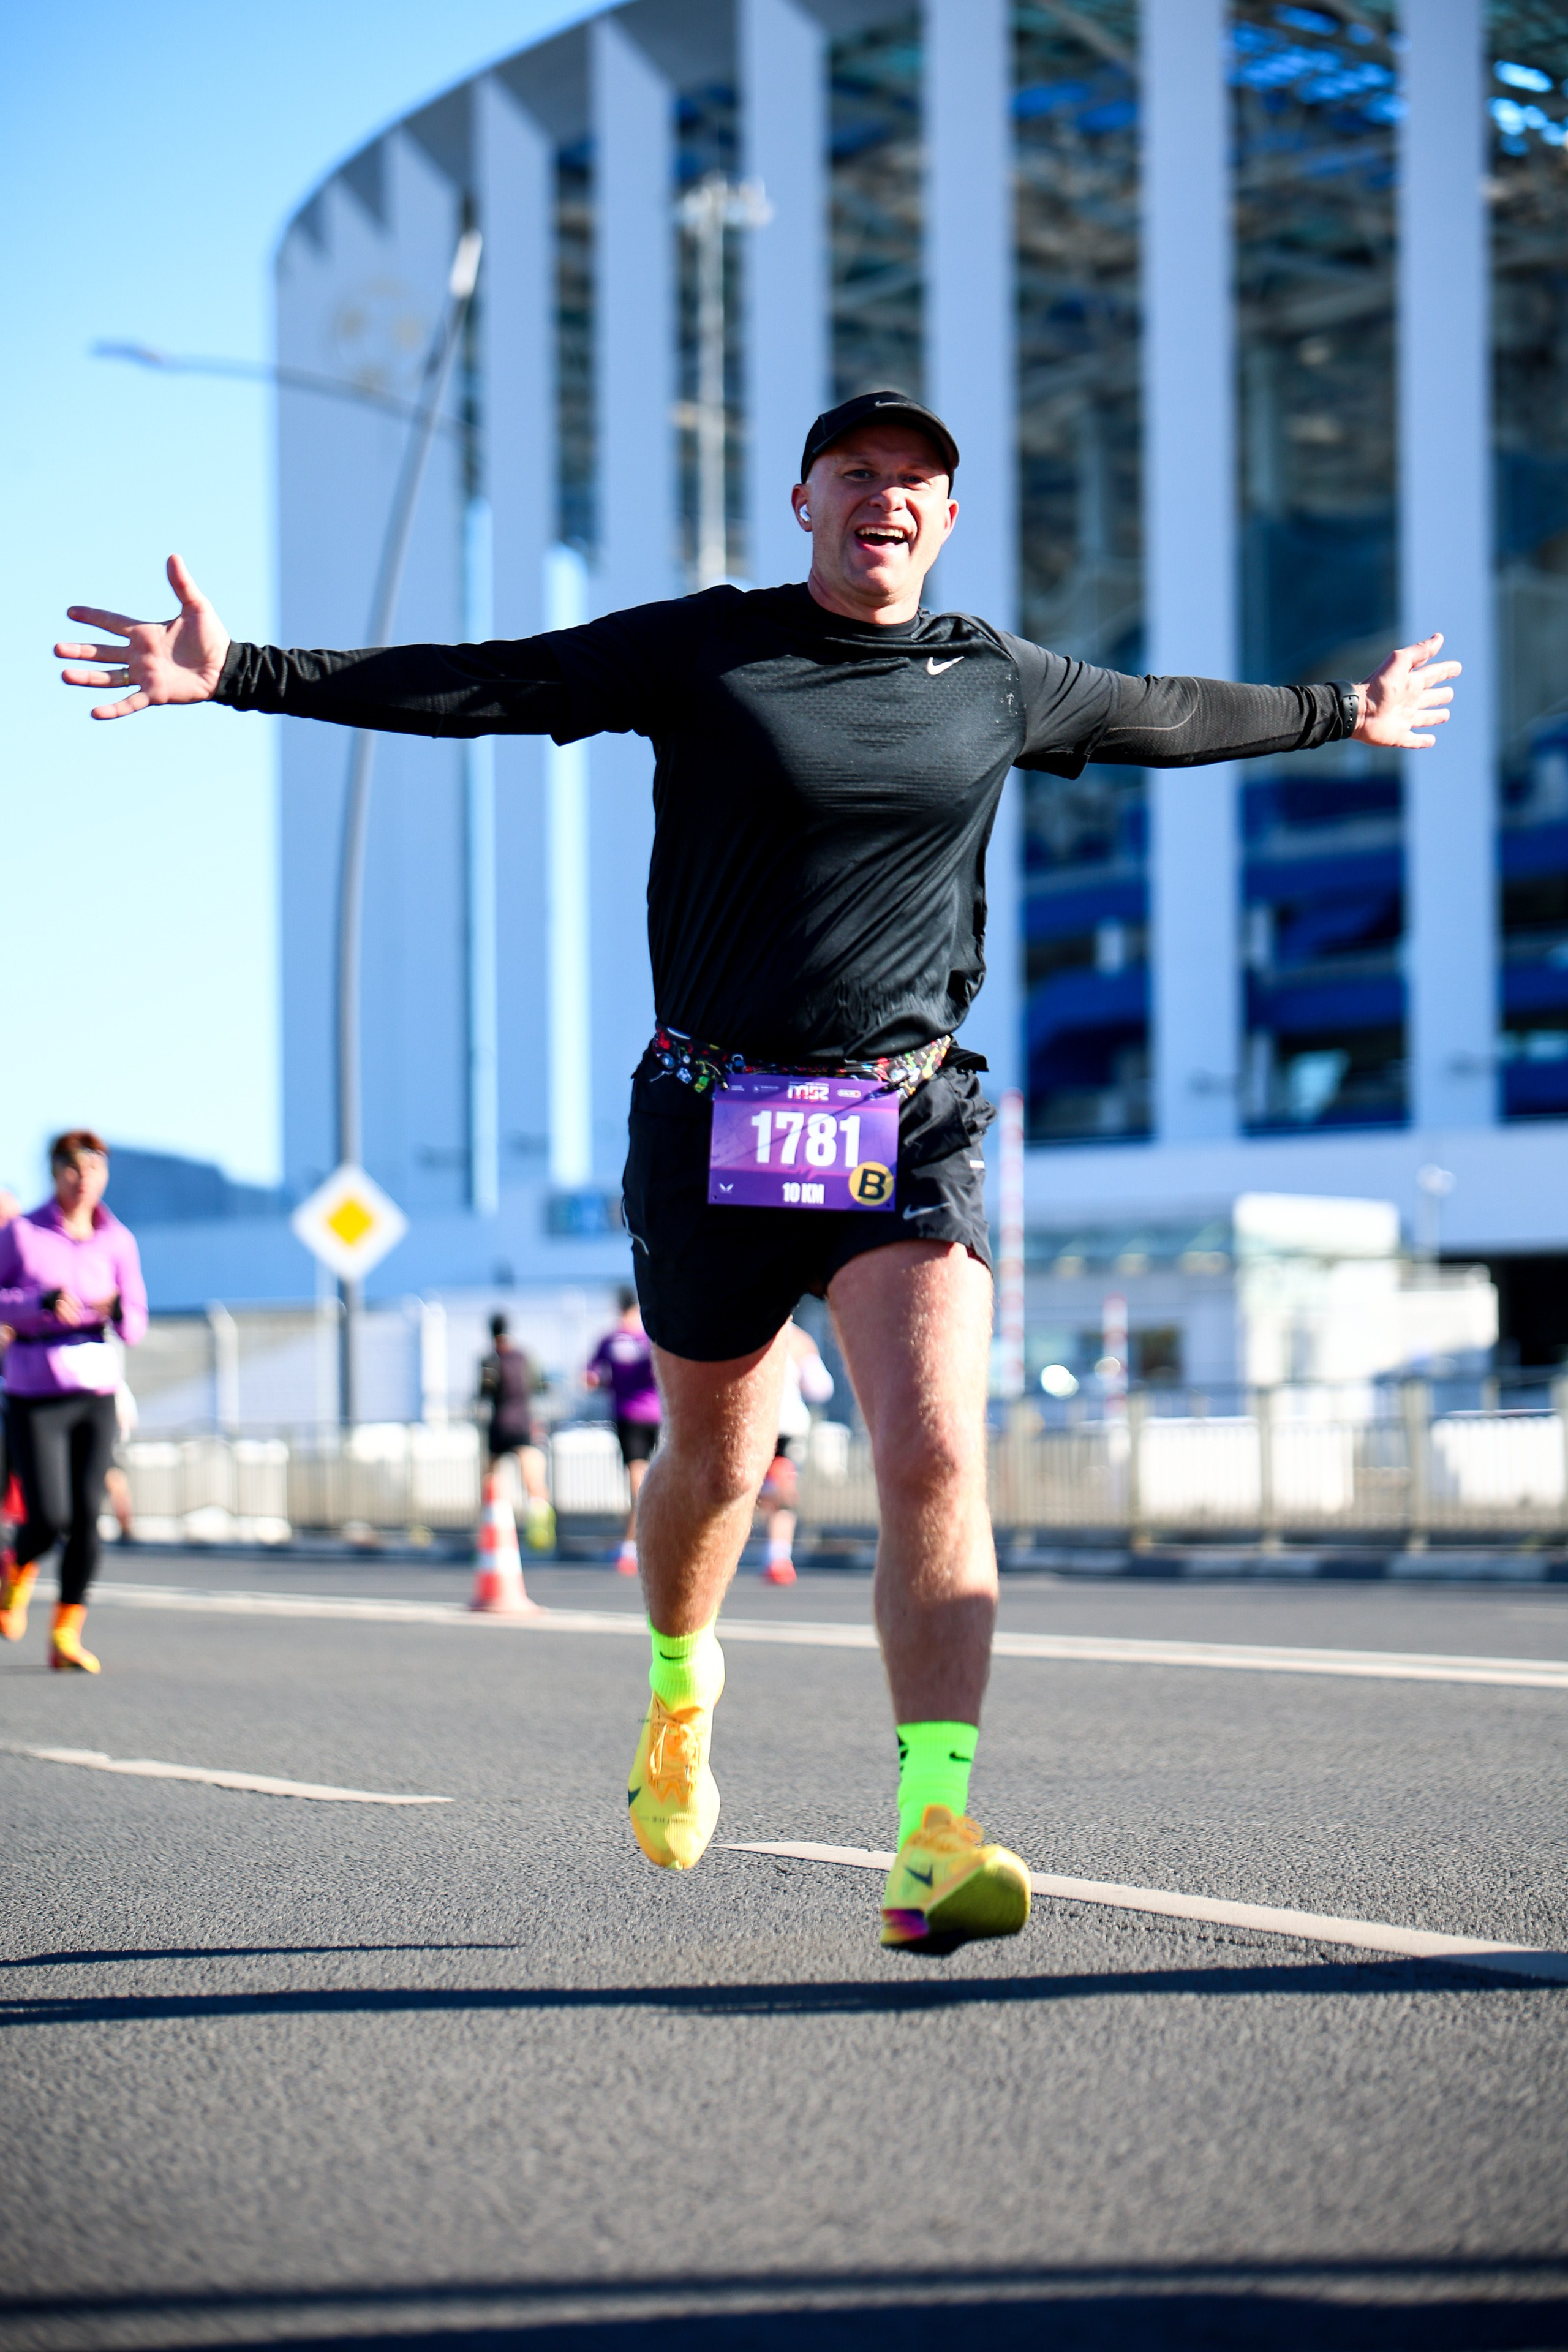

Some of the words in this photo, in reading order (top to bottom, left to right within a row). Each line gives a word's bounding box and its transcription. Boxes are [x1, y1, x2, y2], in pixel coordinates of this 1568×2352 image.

[752, 1110, 861, 1167] 1781
[782, 1182, 801, 1203] 10
[801, 1182, 825, 1204] KM
[858, 1168, 886, 1200] B
